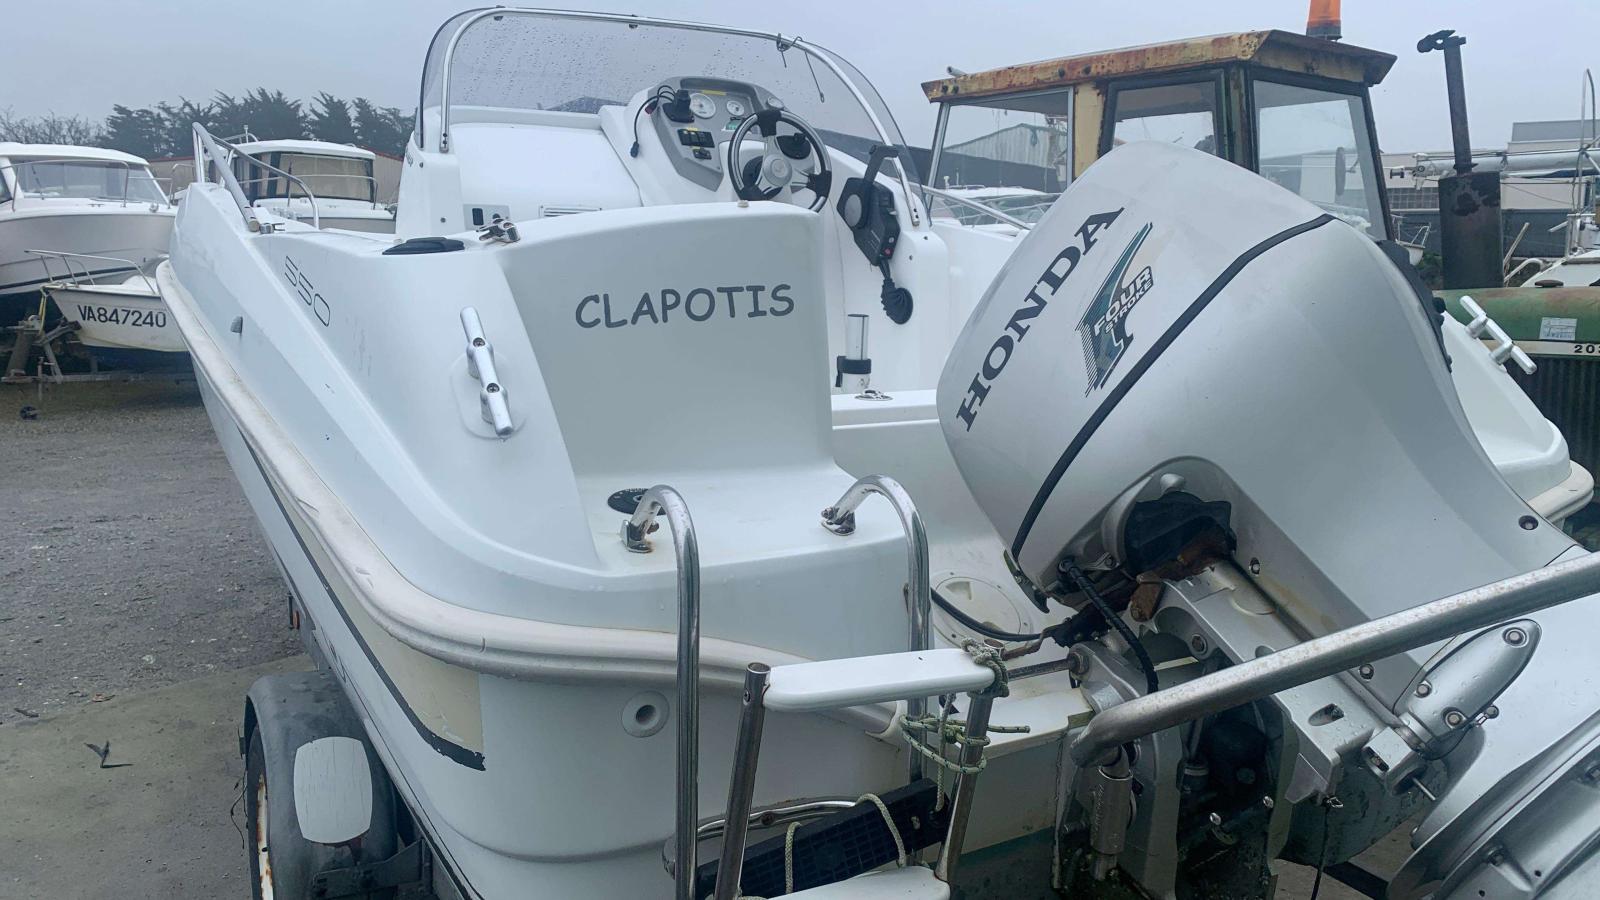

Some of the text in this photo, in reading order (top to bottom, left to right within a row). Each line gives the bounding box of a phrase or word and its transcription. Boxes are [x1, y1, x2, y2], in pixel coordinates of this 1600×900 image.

[77, 304, 167, 328] VA847240
[285, 256, 331, 327] 550
[575, 284, 795, 329] CLAPOTIS
[956, 207, 1124, 432] HONDA
[1094, 267, 1151, 337] FOUR
[1105, 279, 1152, 334] STROKE
